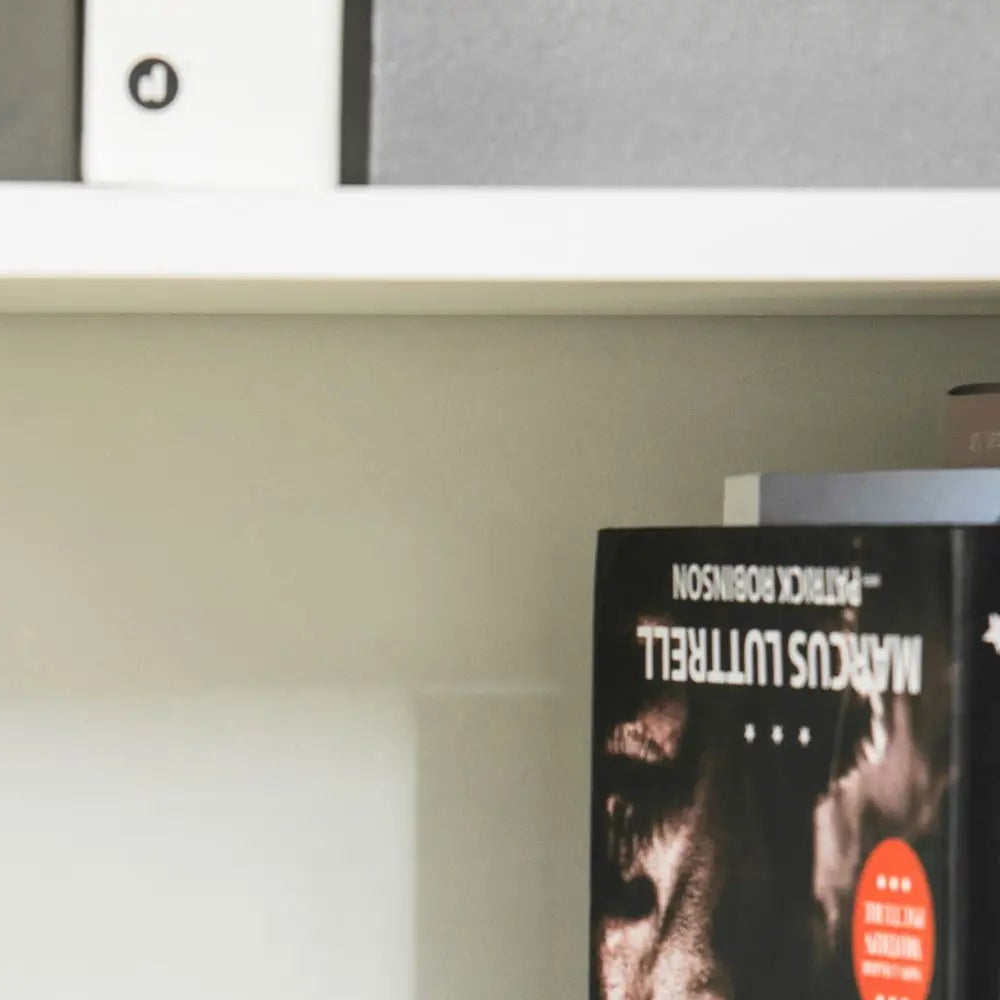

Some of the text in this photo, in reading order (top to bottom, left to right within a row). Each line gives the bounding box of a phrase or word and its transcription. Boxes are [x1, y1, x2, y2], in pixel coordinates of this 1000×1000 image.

[671, 562, 863, 607] PATRICK ROBINSON
[636, 625, 923, 695] MARCUS LUTTRELL
